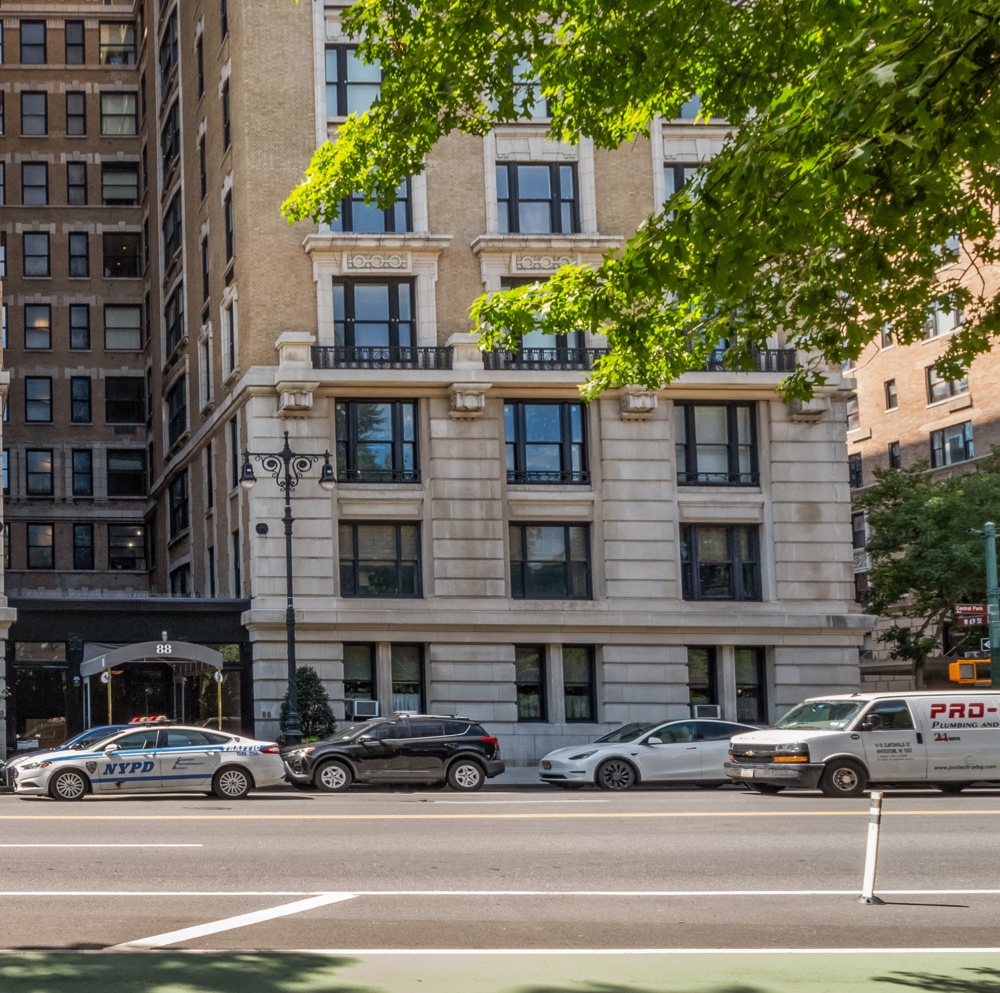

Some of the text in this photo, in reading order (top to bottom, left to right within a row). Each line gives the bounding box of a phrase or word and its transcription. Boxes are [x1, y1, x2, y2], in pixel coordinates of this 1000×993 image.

[156, 644, 172, 654] 88
[261, 711, 272, 719] 88
[934, 733, 948, 742] 24
[103, 761, 155, 776] NYPD
